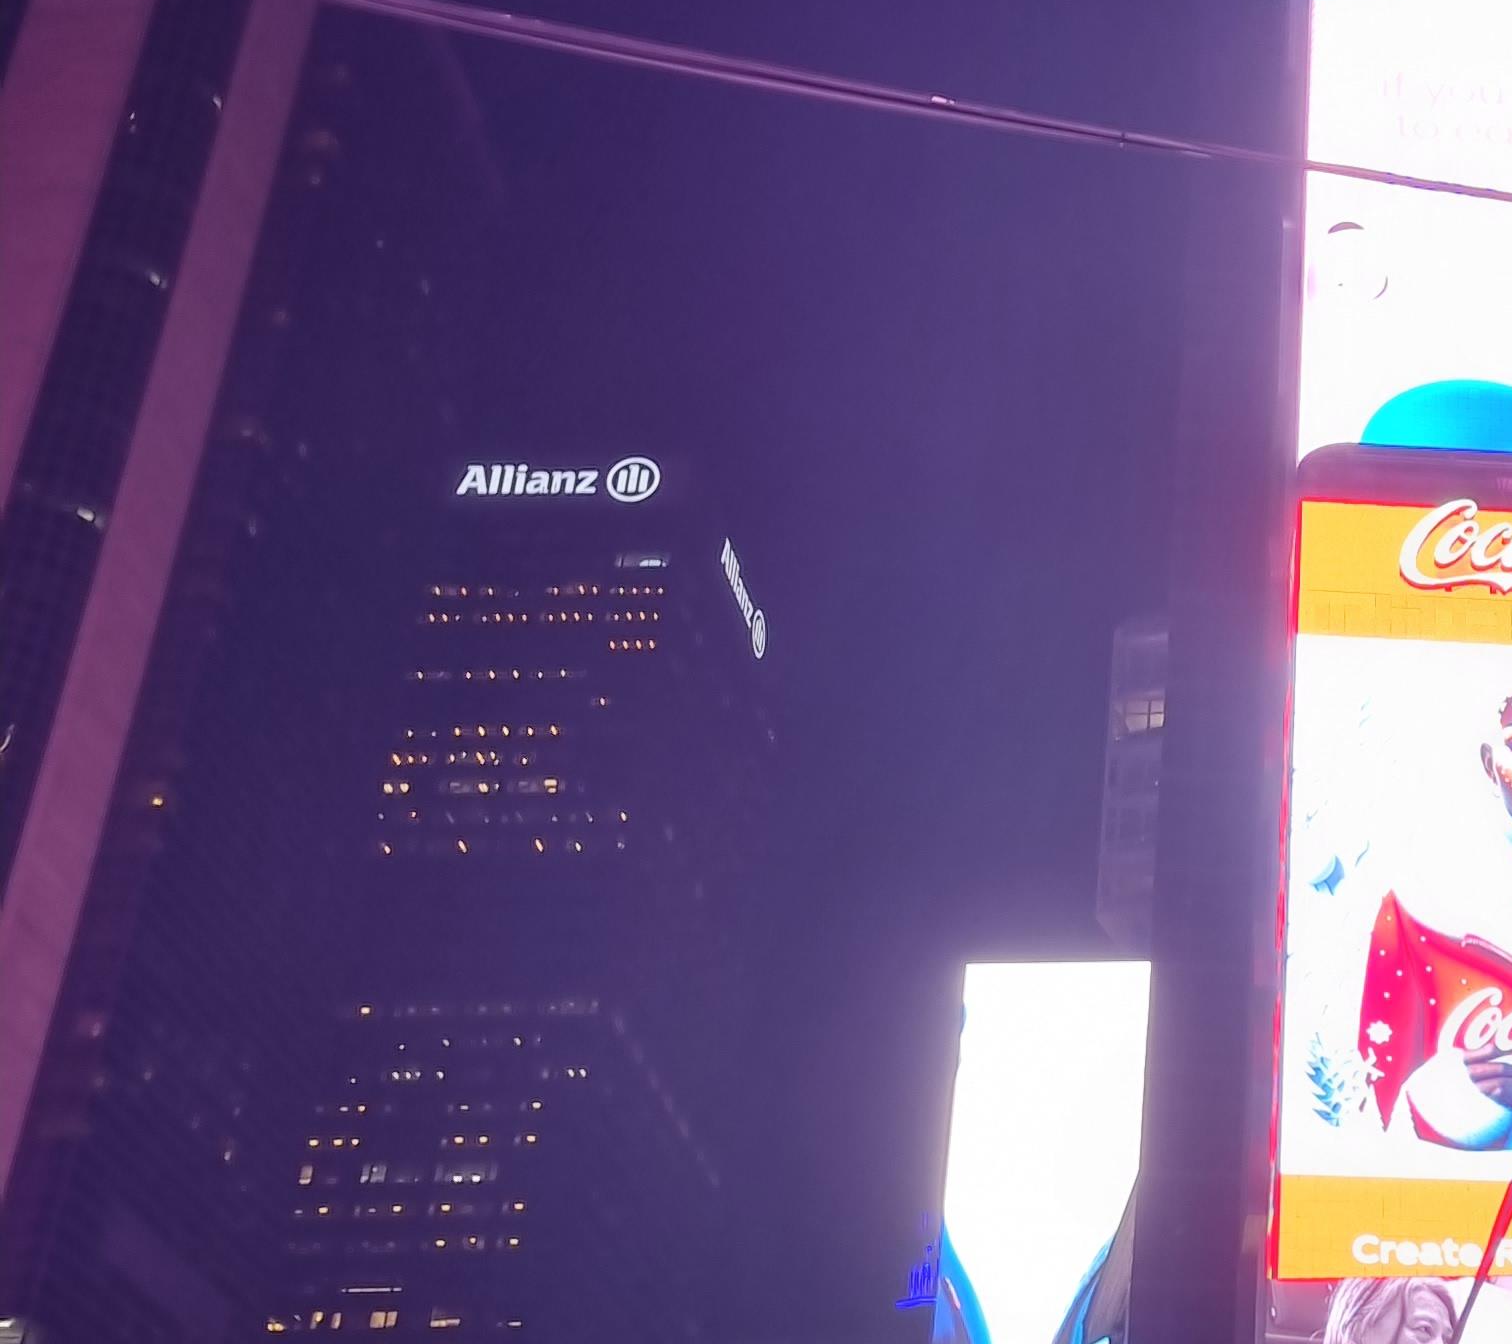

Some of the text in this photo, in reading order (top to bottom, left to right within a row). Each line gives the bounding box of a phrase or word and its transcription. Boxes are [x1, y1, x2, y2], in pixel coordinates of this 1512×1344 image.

[456, 463, 600, 496] Allianz
[720, 537, 753, 629] Allianz
[1352, 1233, 1484, 1269] Create
